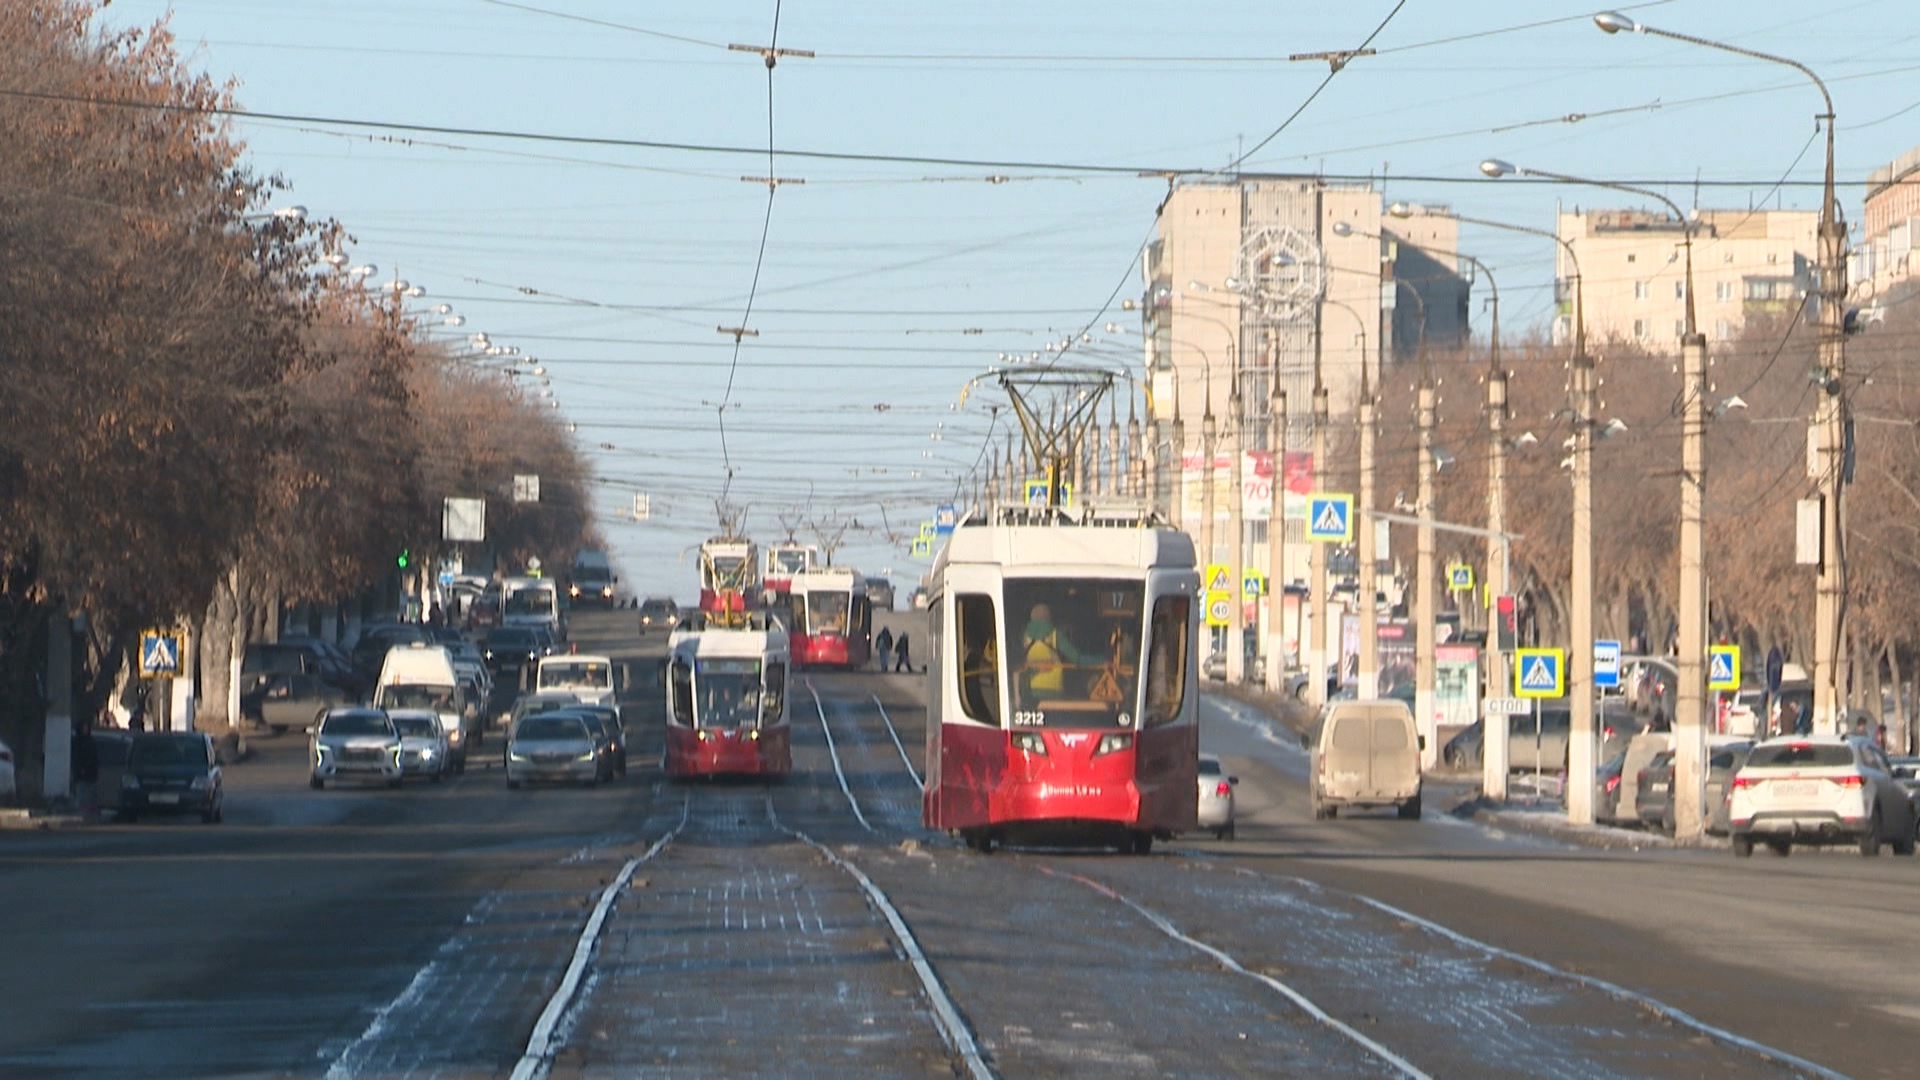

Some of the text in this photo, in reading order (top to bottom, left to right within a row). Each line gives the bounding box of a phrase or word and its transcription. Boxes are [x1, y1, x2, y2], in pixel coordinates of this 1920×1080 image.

[1214, 604, 1227, 615] 40
[1489, 700, 1523, 711] СТОП
[1014, 711, 1045, 726] 3212
